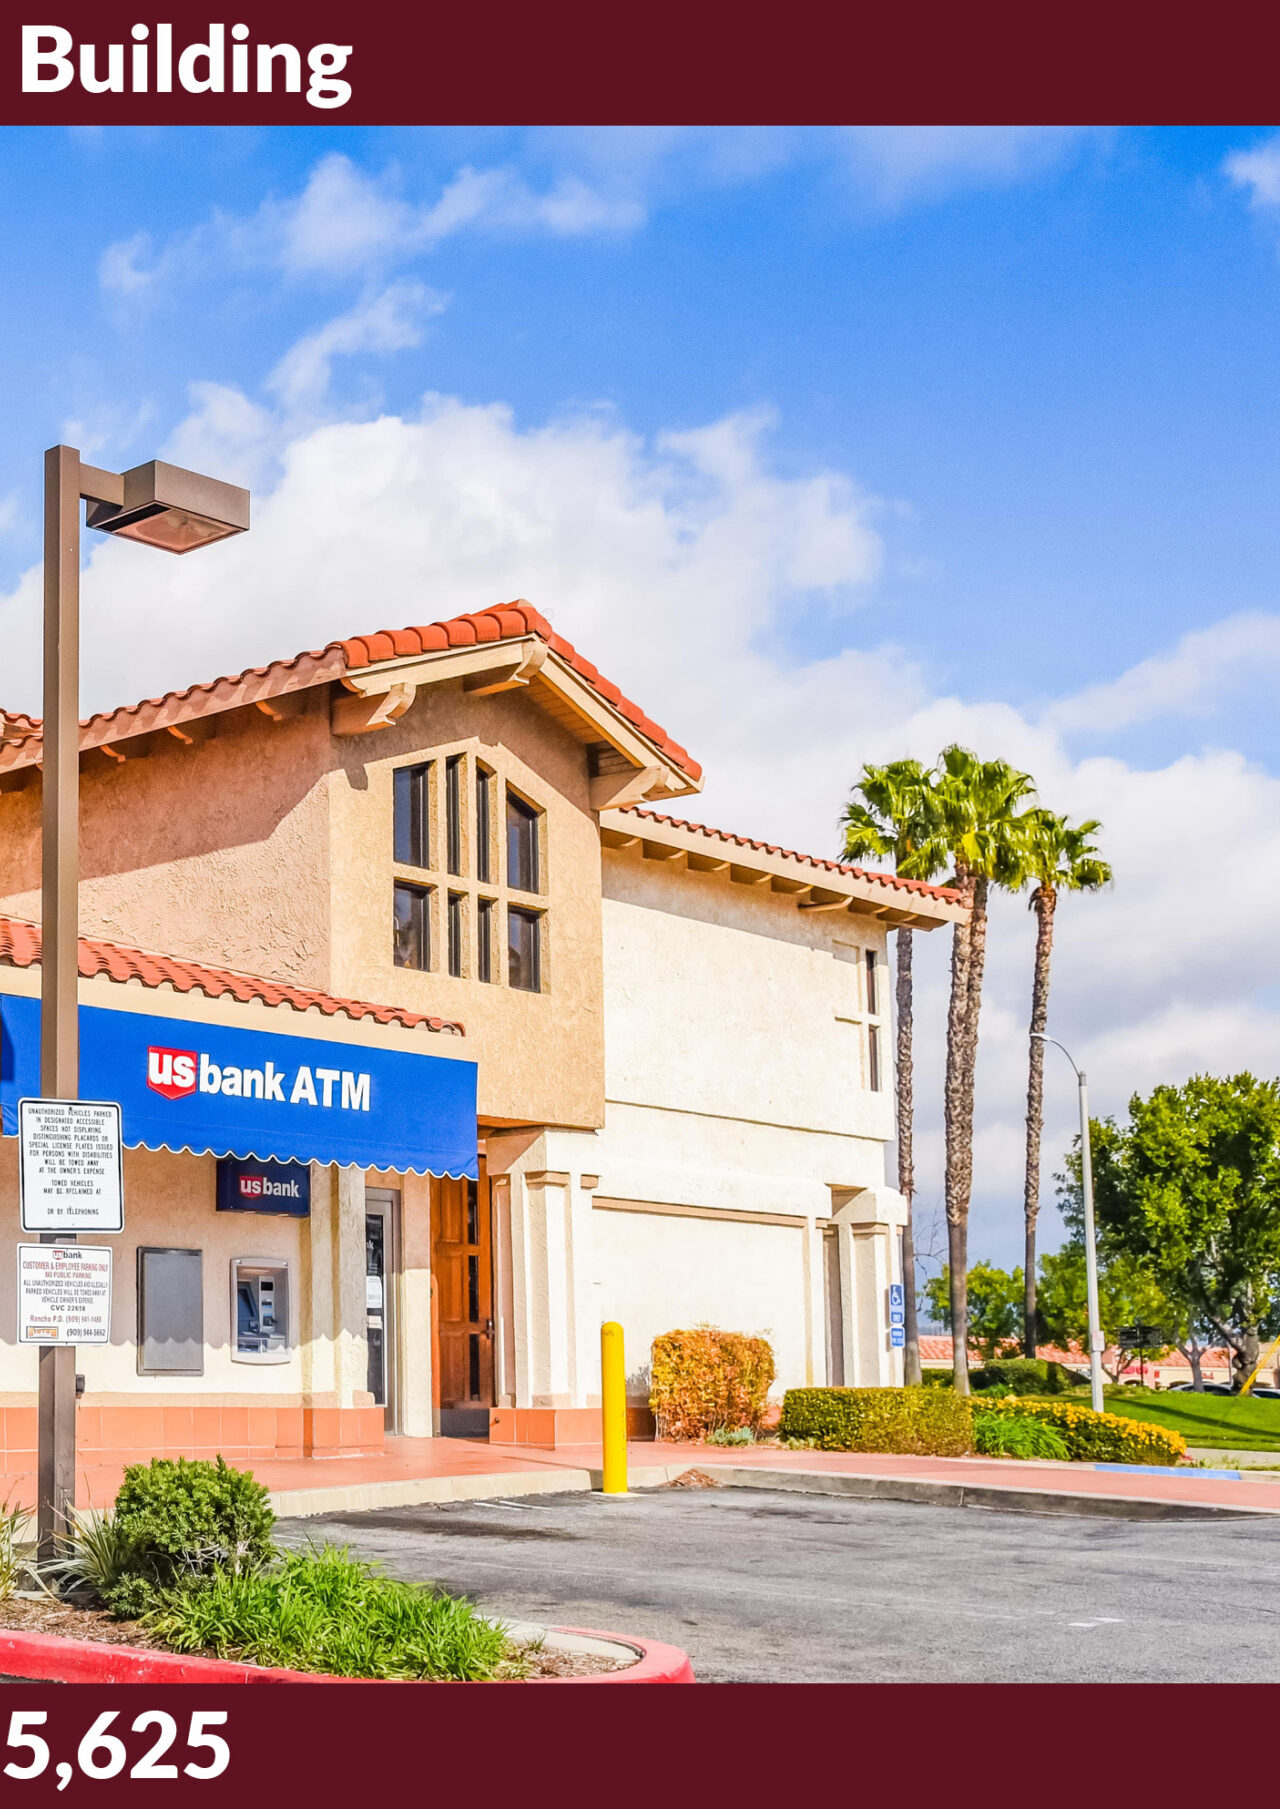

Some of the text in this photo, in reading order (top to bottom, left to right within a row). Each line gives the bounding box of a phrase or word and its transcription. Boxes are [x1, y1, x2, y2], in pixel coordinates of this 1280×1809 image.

[290, 1066, 371, 1111] ATM
[53, 1250, 82, 1260] bank
[23, 1261, 49, 1269] CUSTOMER
[56, 1262, 80, 1271] EMPLOYEE
